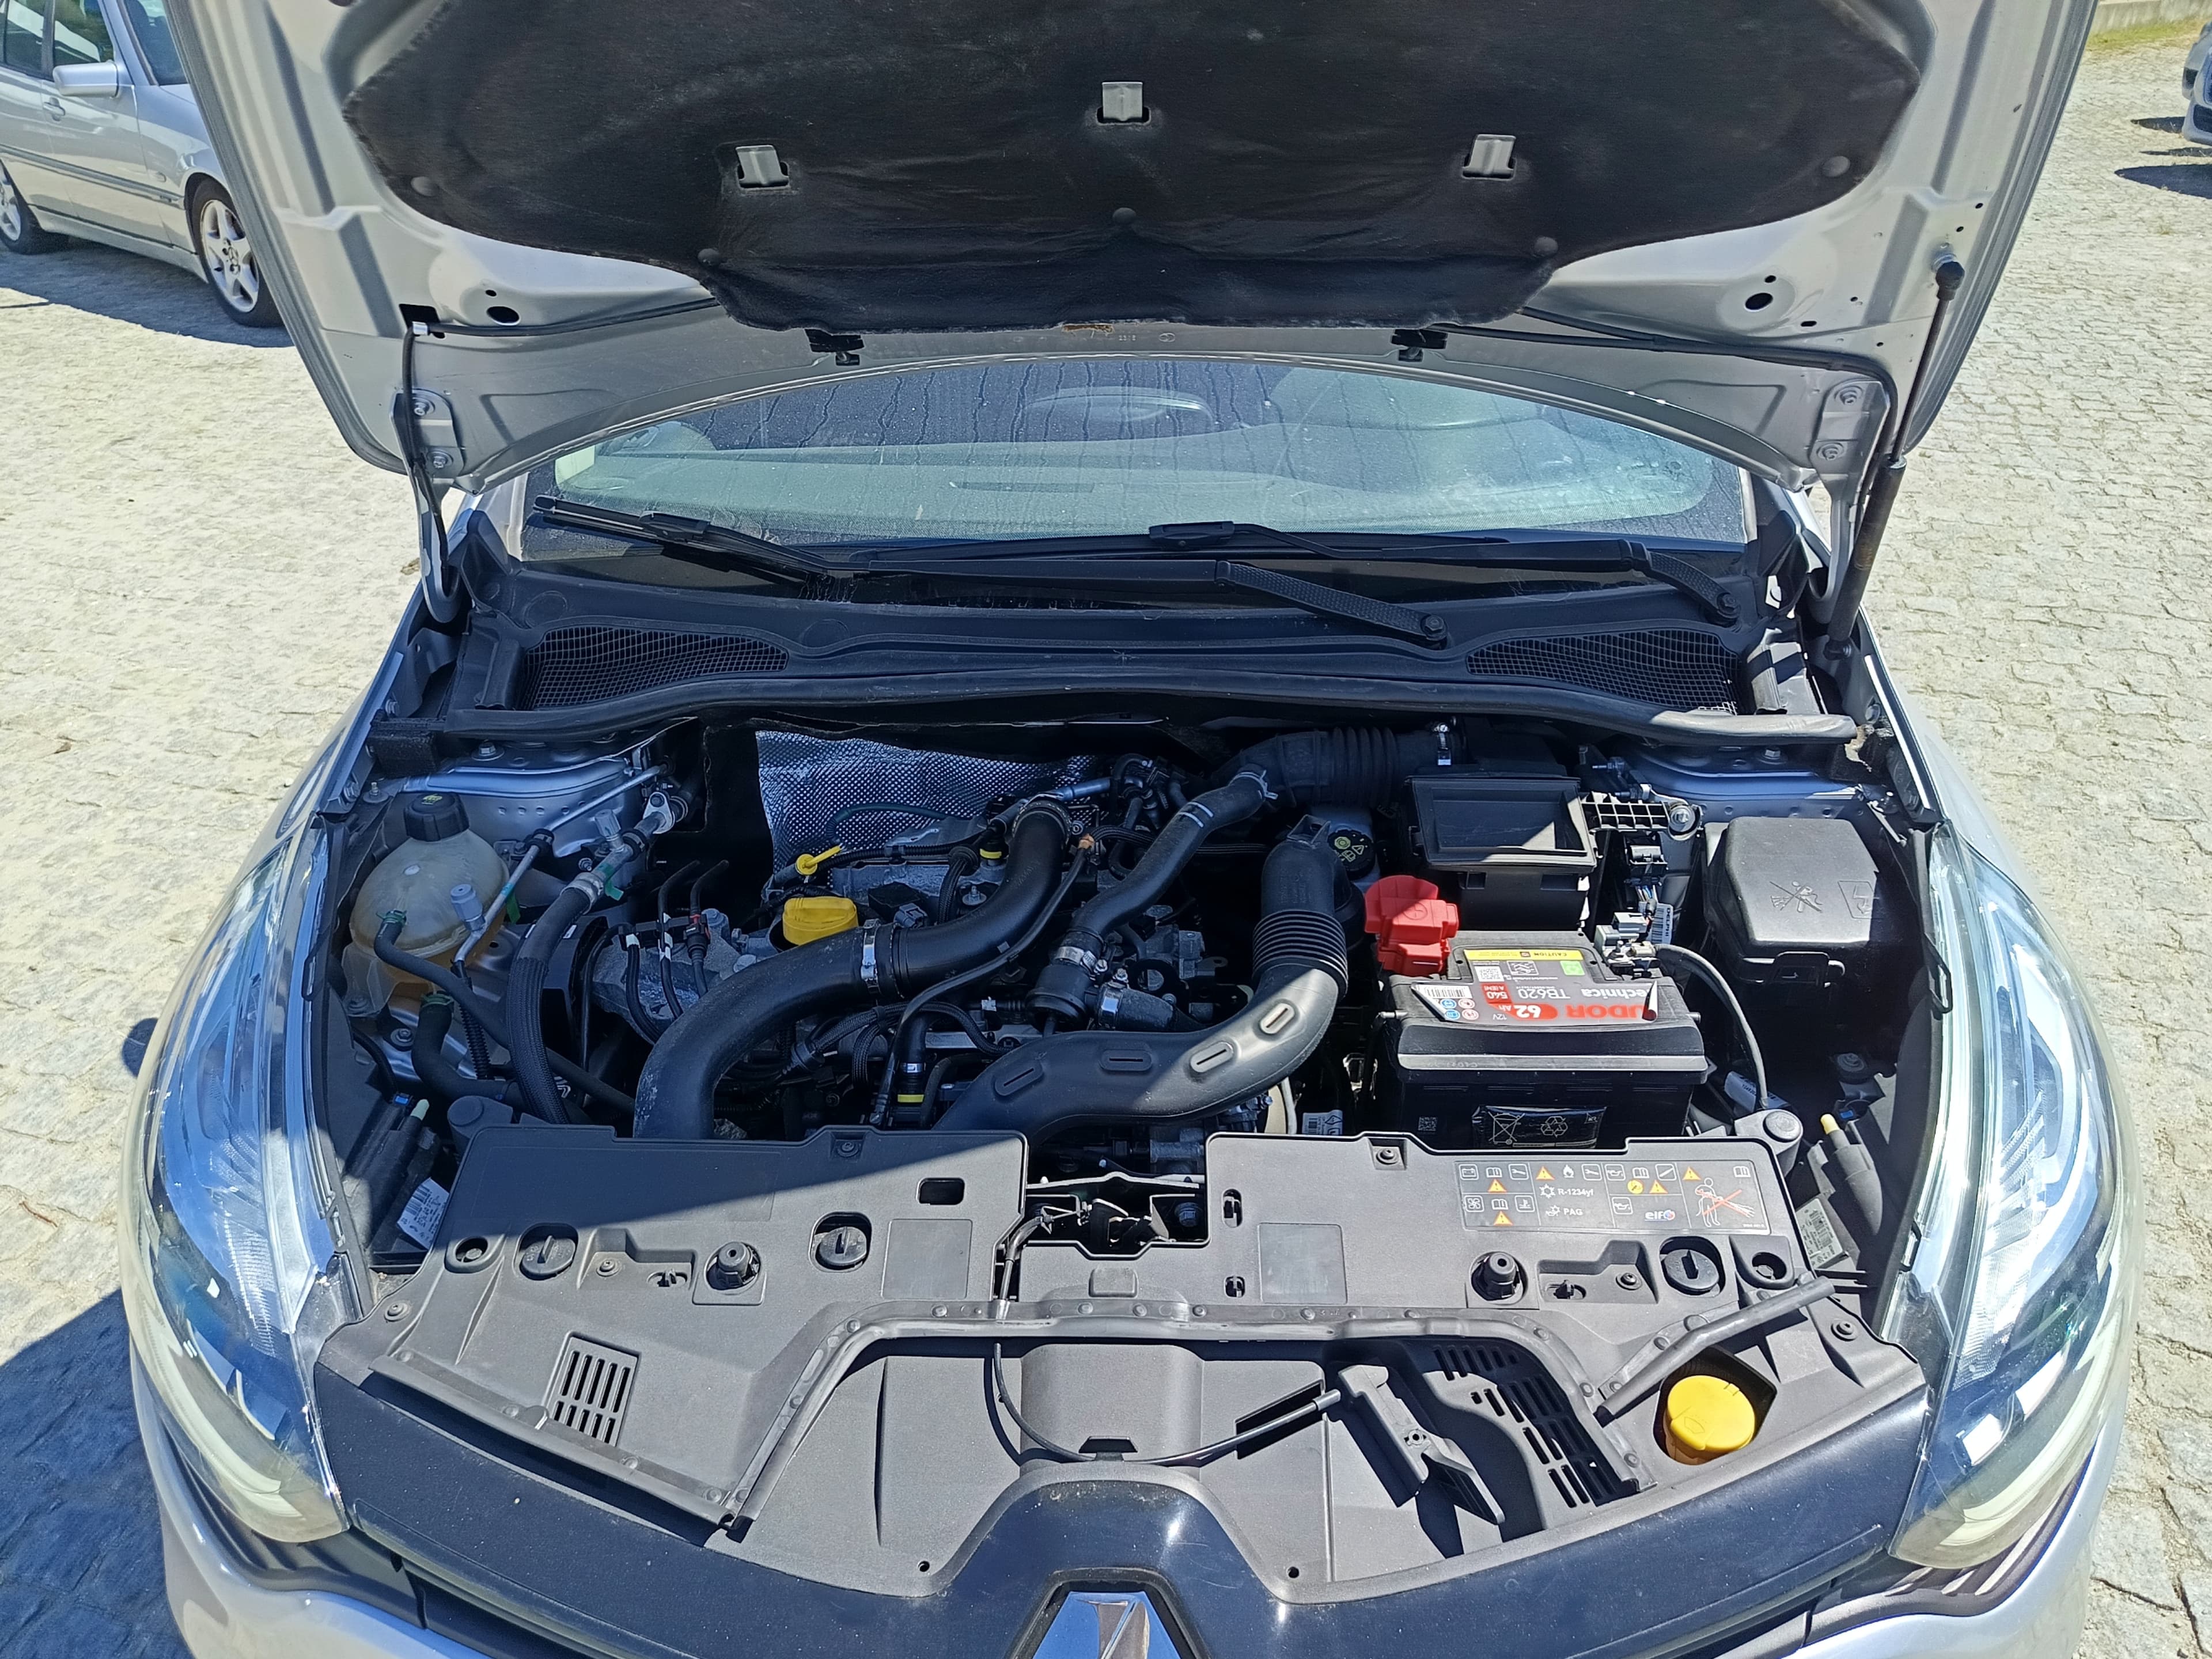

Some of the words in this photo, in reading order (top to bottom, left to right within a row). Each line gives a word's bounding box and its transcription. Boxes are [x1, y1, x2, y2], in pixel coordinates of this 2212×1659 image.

[1486, 991, 1508, 999] 540
[1518, 989, 1571, 999] TB620
[1581, 988, 1648, 999] echnica
[1514, 1005, 1541, 1018] 62
[1563, 1208, 1583, 1216] PAG
